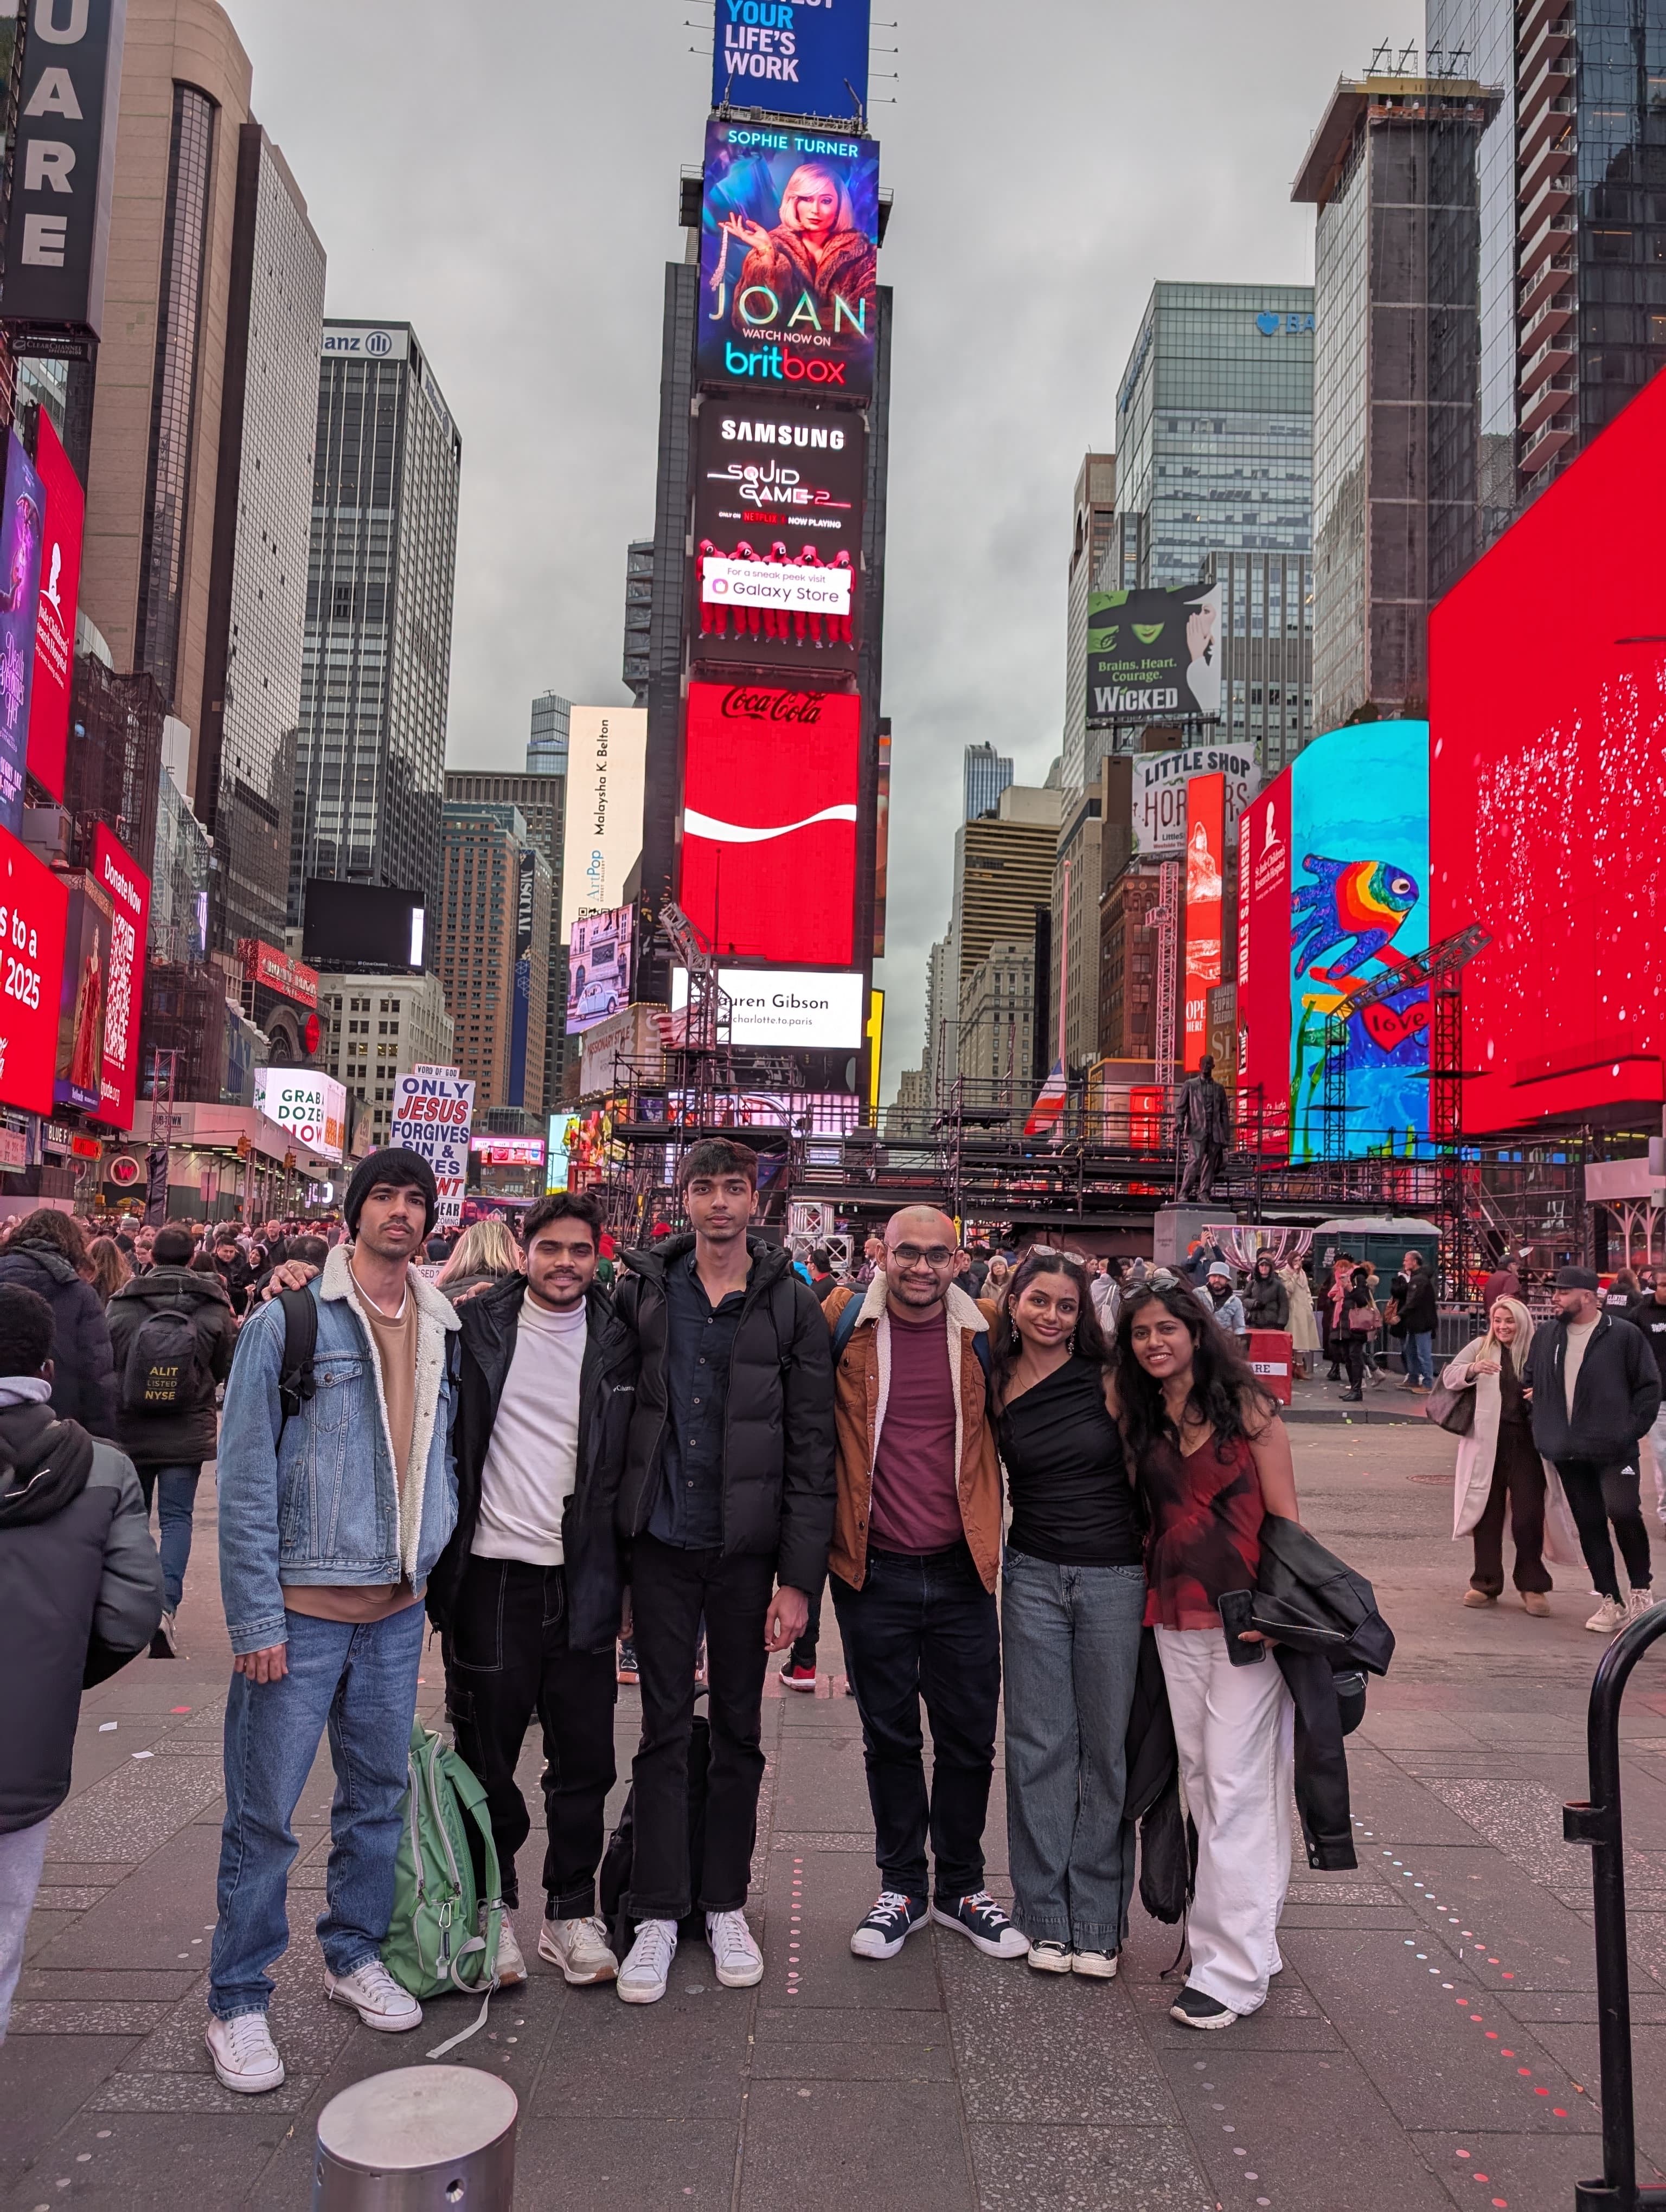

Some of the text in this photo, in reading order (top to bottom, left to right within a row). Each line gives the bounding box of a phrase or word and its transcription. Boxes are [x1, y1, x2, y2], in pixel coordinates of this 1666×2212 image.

[727, 0, 793, 29] YOUR
[726, 24, 796, 55] LIFE'S
[725, 50, 799, 82] WORK
[728, 130, 858, 158] SOPHIE TURNER
[708, 282, 867, 337] JOAN
[742, 328, 831, 346] WATCH NOW ON
[726, 342, 845, 384] britbox
[721, 420, 845, 449] SAMSUNG
[707, 460, 800, 486] SQUID
[739, 485, 851, 508] GAME 2
[744, 512, 777, 524] NETFLIX
[788, 516, 808, 526] NOW
[808, 518, 842, 529] PLAYING
[727, 568, 740, 576] For
[753, 571, 780, 580] sneak
[783, 573, 805, 582] peek
[809, 575, 825, 583] visit
[733, 582, 839, 603] Galaxy Store
[6, 631, 24, 683] Death
[1098, 658, 1177, 672] Brains. Heart.
[1112, 671, 1163, 683] Courage.
[721, 686, 826, 724] Coca-Cola
[593, 719, 609, 835] Malaysha K. Belton
[1145, 751, 1251, 787] LITTLE SHOP
[105, 854, 142, 915] Donate Now
[586, 850, 604, 903] ArtPop
[1240, 815, 1250, 987] HERSHEY'S STORE
[12, 908, 27, 950] to
[29, 929, 37, 959] a
[5, 957, 41, 1010] 2025
[718, 993, 829, 1009] auren Gibson
[1187, 1020, 1204, 1033] HERE
[1373, 1013, 1425, 1032] love
[418, 1065, 458, 1077] WORD OF GOD
[282, 1089, 321, 1104] GRAB
[321, 1094, 324, 1106] A
[402, 1077, 471, 1099] ONLY
[278, 1105, 324, 1124] DOZEN
[398, 1095, 469, 1125] JESUS
[49, 1124, 62, 1143] BLUE
[283, 1123, 323, 1143] NOW
[392, 1120, 470, 1144] FORGIVES
[402, 1140, 454, 1159] SIN &
[438, 1201, 460, 1217] EAR
[437, 1217, 459, 1225] COMING
[418, 1268, 434, 1278] SED
[149, 1366, 178, 1376] ALIT
[145, 1390, 176, 1400] NYSE
